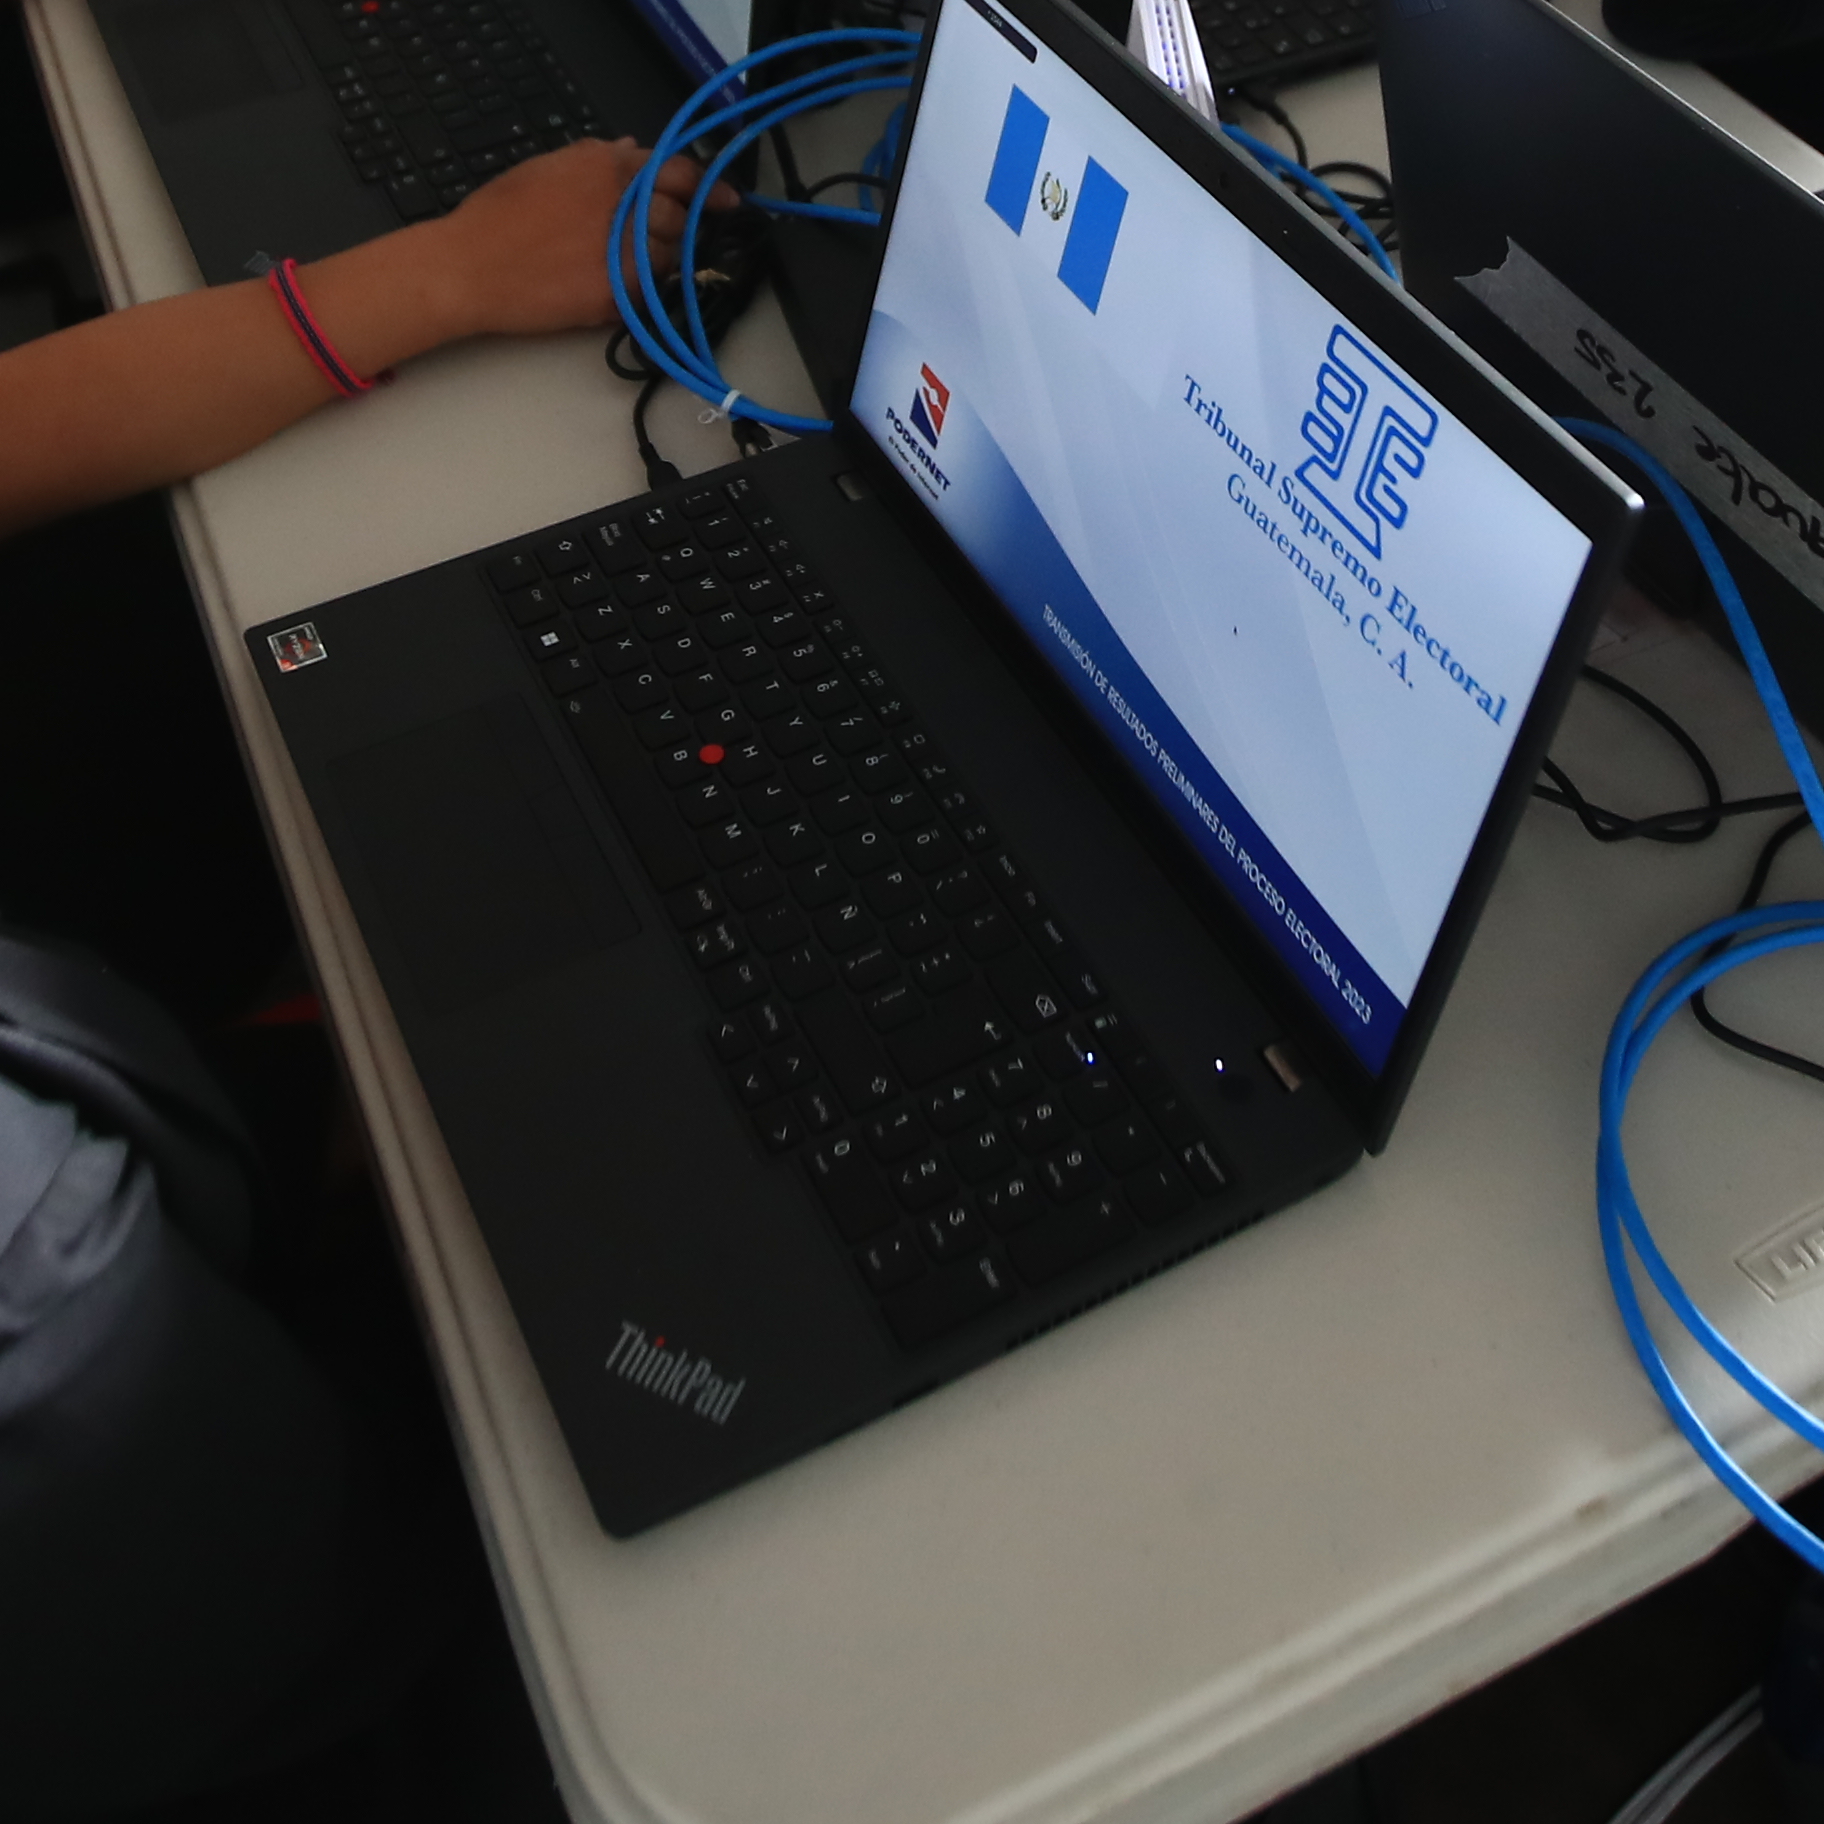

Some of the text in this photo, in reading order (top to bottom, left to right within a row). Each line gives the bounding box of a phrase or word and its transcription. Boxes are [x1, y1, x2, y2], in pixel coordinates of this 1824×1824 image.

[1574, 329, 1656, 419] 235
[886, 407, 951, 491] PODERNET
[1183, 374, 1509, 726] Tribunal Supremo Electoral
[700, 578, 715, 589] W
[750, 582, 761, 590] 3
[1227, 473, 1415, 689] Guatemala, C. A.
[598, 606, 612, 615] Z
[657, 605, 670, 614] S
[721, 613, 734, 621] E
[618, 639, 632, 649] X
[678, 638, 691, 647] D
[742, 646, 756, 656] R
[793, 649, 807, 657] 5
[639, 675, 652, 684] C
[699, 673, 714, 682] F
[766, 681, 779, 689] T
[661, 710, 674, 719] V
[721, 710, 734, 721] G
[790, 717, 803, 725] Y
[674, 750, 687, 760] B
[743, 746, 758, 757] H
[813, 754, 826, 765] U
[866, 757, 878, 765] 8
[703, 785, 717, 798] N
[891, 795, 903, 804] 9
[1042, 603, 1373, 1025] TRANSMISIÓN DE RESULTADOS PRELIMINARES DEL PROCESO ELECTORAL 2023
[726, 824, 741, 838] M
[790, 824, 804, 835] K
[815, 865, 826, 876] L
[888, 873, 902, 882] P
[1037, 1106, 1051, 1118] 8
[980, 1134, 994, 1146] 5
[1067, 1154, 1081, 1165] 9
[1009, 1182, 1024, 1195] 6
[950, 1210, 964, 1225] 3
[605, 1319, 747, 1426] ThinkPad
